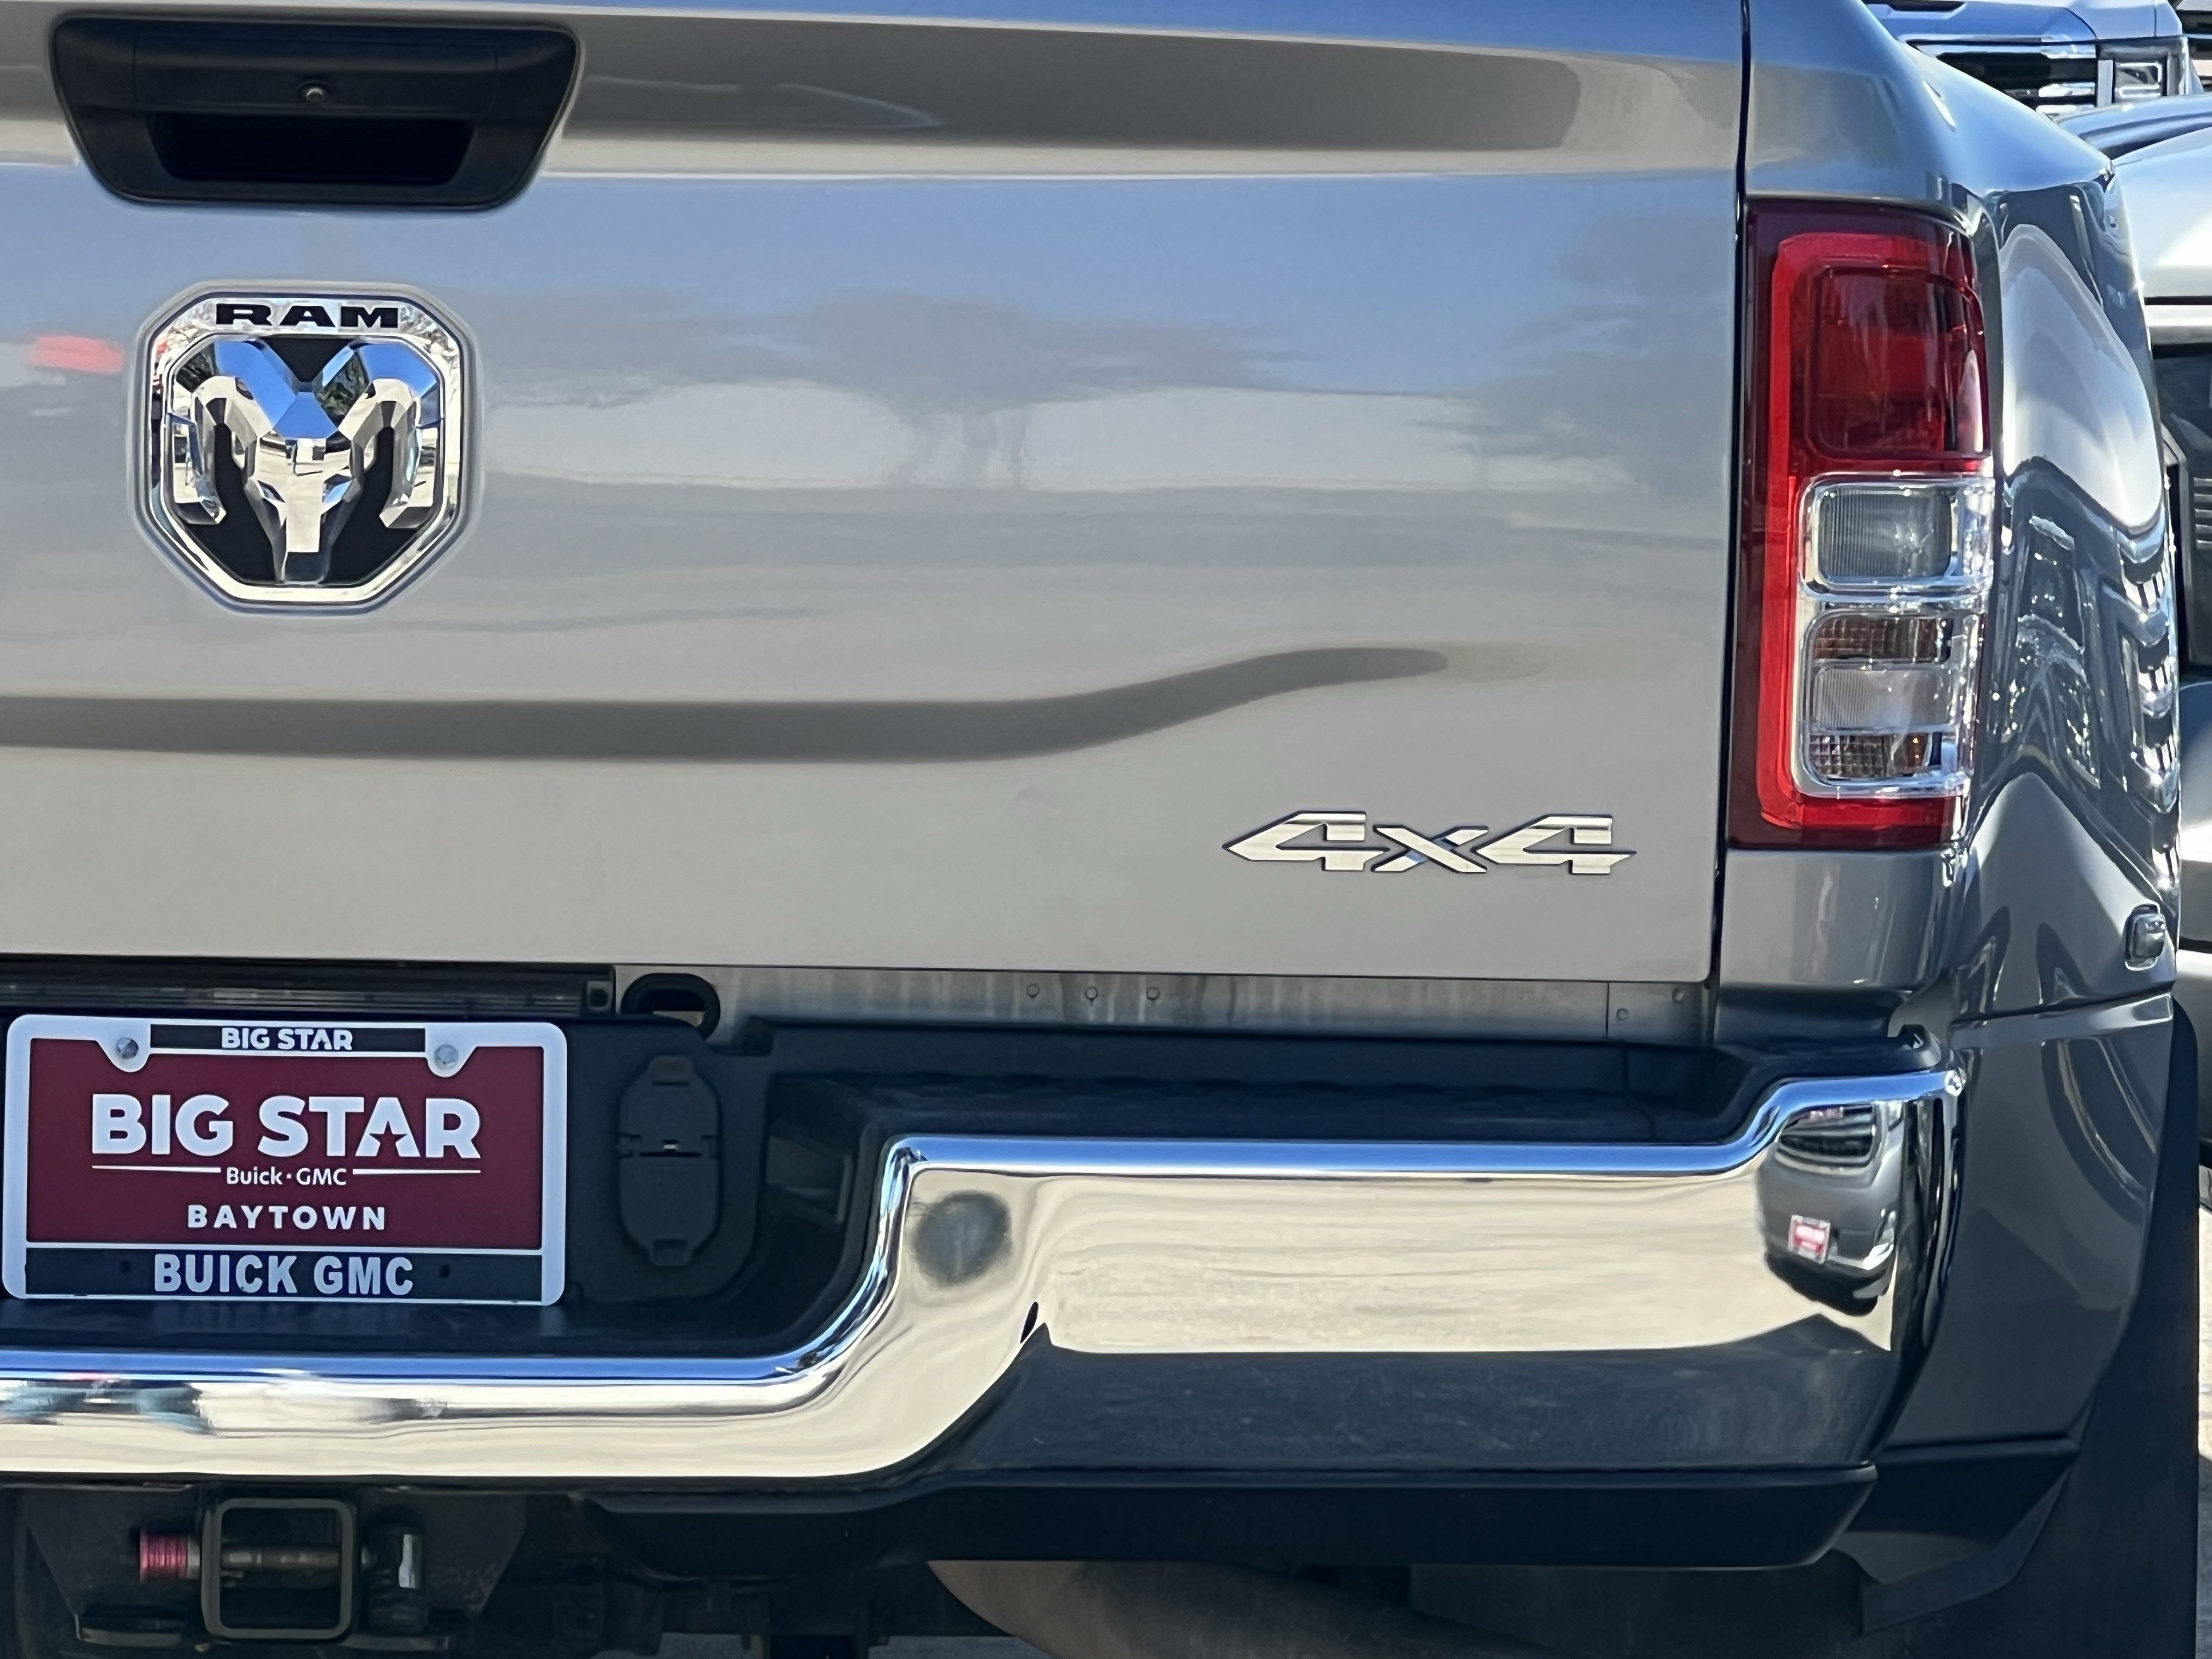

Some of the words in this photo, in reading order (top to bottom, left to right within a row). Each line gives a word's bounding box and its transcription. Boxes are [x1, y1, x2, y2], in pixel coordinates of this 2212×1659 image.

[216, 303, 399, 329] RAM
[1222, 810, 1637, 874] 4x4
[221, 1028, 269, 1049] BIG
[278, 1028, 353, 1051] STAR
[92, 1094, 234, 1156] BIG
[258, 1095, 481, 1159] STAR
[227, 1166, 283, 1186] Buick
[296, 1168, 347, 1186] GMC
[188, 1205, 385, 1230] BAYTOWN
[154, 1254, 297, 1294] BUICK
[314, 1256, 413, 1296] GMC
